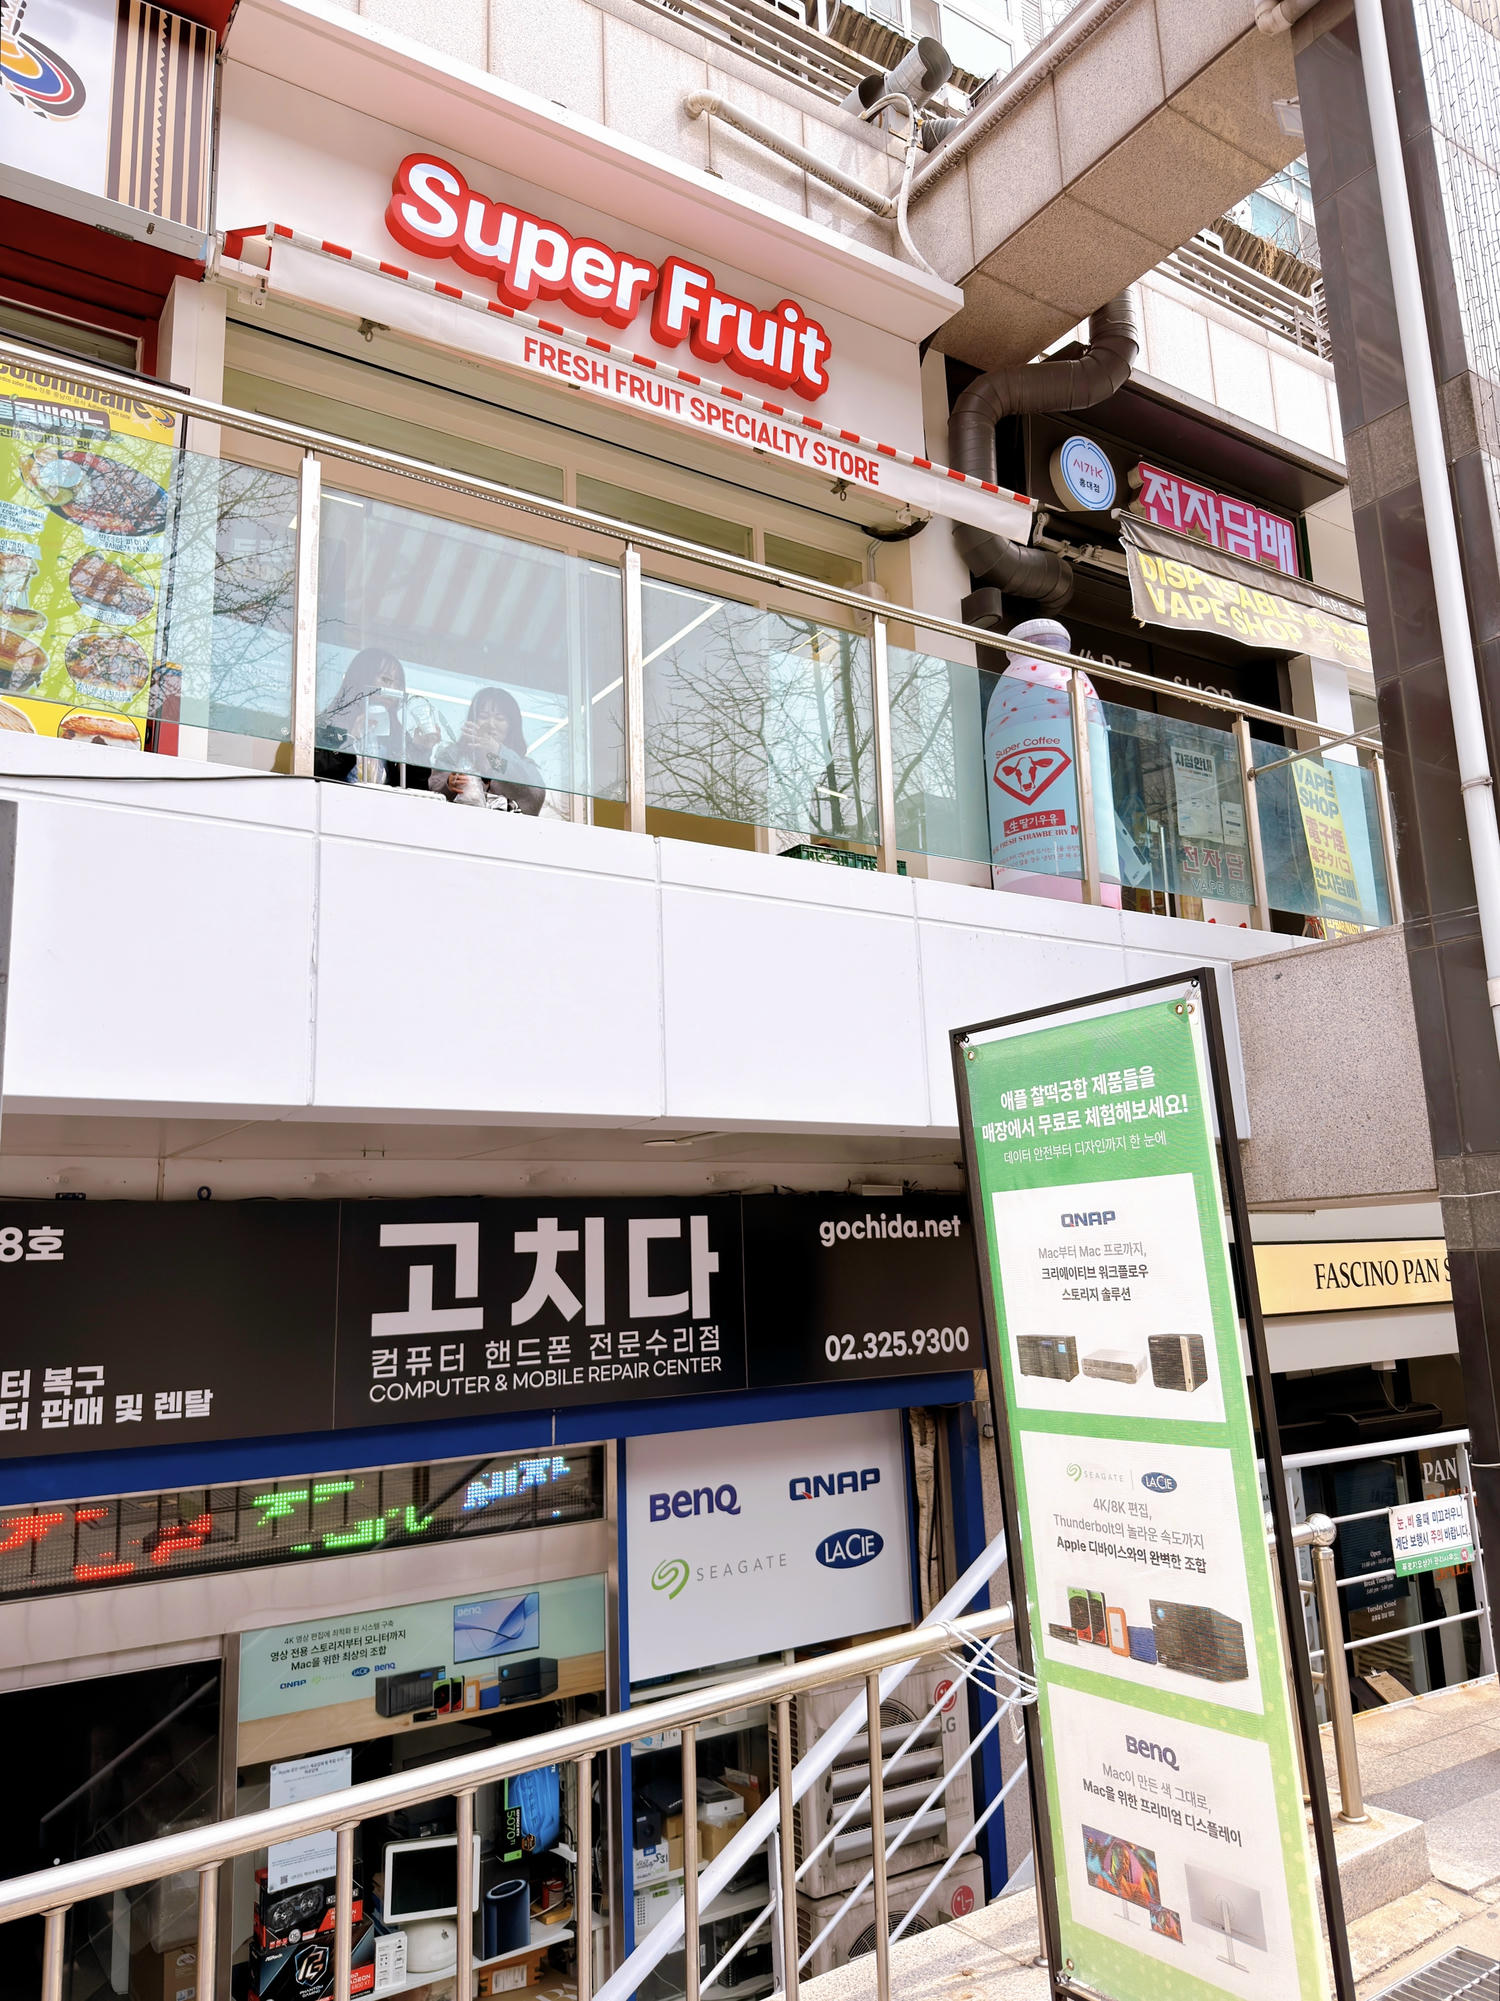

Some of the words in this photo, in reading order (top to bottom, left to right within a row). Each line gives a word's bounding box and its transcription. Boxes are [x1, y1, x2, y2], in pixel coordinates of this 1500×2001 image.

[401, 163, 650, 311] Super
[665, 264, 825, 385] Fruit
[524, 338, 609, 389] FRESH
[615, 369, 684, 414] FRUIT
[690, 397, 810, 460] SPECIALTY
[813, 441, 879, 485] STORE
[1080, 478, 1100, 493] 홍대점
[1141, 470, 1296, 575] 전자담배
[1138, 551, 1306, 622] DISPOSABLE
[1311, 591, 1348, 615] VAPE
[1145, 582, 1231, 629] VAPE
[1229, 608, 1304, 645] SHOP
[995, 742, 1021, 760] Super
[1023, 736, 1060, 747] Coffee
[1295, 762, 1335, 798] VAPE
[1299, 789, 1338, 819] SHOP
[1192, 877, 1225, 895] VAPE
[1000, 1089, 1028, 1111] 애플
[1030, 1077, 1088, 1107] 찰떡궁합
[1092, 1065, 1155, 1096] 제품들을
[982, 1116, 1035, 1143] 매장에서
[1038, 1110, 1082, 1135] 무료로
[1085, 1094, 1189, 1129] 체험해보세요!
[1004, 1149, 1032, 1164] 데이터
[1034, 1143, 1072, 1161] 안전부터
[1075, 1136, 1126, 1155] 디자인까지
[1129, 1132, 1140, 1149] 한
[1144, 1130, 1167, 1147] 눈에
[819, 1214, 961, 1247] gochida.net
[1060, 1210, 1116, 1228] QNAP
[1038, 1245, 1077, 1259] Mac부터
[1079, 1246, 1101, 1258] Mac
[1103, 1241, 1147, 1257] 프로까지,
[371, 1215, 719, 1337] 고치다
[1042, 1266, 1097, 1280] 크리에이티브
[1099, 1264, 1149, 1279] 워크플로우
[1314, 1259, 1399, 1290] FASCINO
[1402, 1258, 1440, 1284] PAN
[1062, 1287, 1099, 1301] 스토리지
[1101, 1287, 1132, 1301] 솔루션
[372, 1343, 465, 1379] 컴퓨터
[485, 1335, 572, 1368] 핸드폰
[589, 1325, 721, 1359] 전문수리점
[825, 1327, 969, 1362] 02.325.9300
[43, 1365, 105, 1397] 복구
[369, 1374, 490, 1403] COMPUTER
[495, 1373, 508, 1392] &
[512, 1366, 584, 1391] MOBILE
[588, 1361, 650, 1384] REPAIR
[653, 1356, 722, 1379] CENTER
[41, 1396, 103, 1430] 판매
[115, 1393, 143, 1422] 및
[154, 1389, 213, 1421] 렌탈
[789, 1468, 880, 1501] QNAP
[1084, 1470, 1125, 1483] SEAGATE
[1422, 1457, 1459, 1484] PAN
[649, 1484, 741, 1522] BenQ
[1093, 1497, 1126, 1515] 4K/8K
[1128, 1501, 1152, 1521] 편집,
[1053, 1513, 1125, 1539] Thunderbolt의
[1127, 1524, 1158, 1543] 놀라운
[1160, 1528, 1205, 1551] 속도까지
[1395, 1536, 1409, 1551] 계단
[1409, 1532, 1429, 1548] 보행시
[1431, 1528, 1444, 1544] 주의
[696, 1553, 788, 1582] SEAGATE
[1057, 1536, 1087, 1554] Apple
[1089, 1541, 1147, 1564] 디바이스와의
[1149, 1551, 1182, 1571] 완벽한
[1184, 1556, 1207, 1574] 조합
[270, 1651, 288, 1662] 영상
[291, 1647, 308, 1659] 전용
[311, 1639, 363, 1655] 스토리지부터
[364, 1629, 407, 1646] 모니터까지
[291, 1657, 321, 1671] Mac을
[322, 1654, 340, 1665] 위한
[342, 1648, 368, 1661] 최상의
[370, 1645, 387, 1657] 조합
[280, 1679, 307, 1689] QNAP
[1125, 1734, 1180, 1771] BenQ
[1102, 1762, 1136, 1787] Mac이
[1137, 1773, 1159, 1794] 만든
[1161, 1783, 1173, 1799] 색
[1175, 1787, 1212, 1815] 그대로,
[507, 1810, 516, 1839] 5070
[1082, 1778, 1116, 1803] Mac을
[1117, 1789, 1138, 1811] 위한
[1140, 1797, 1183, 1826] 프리미엄
[1184, 1813, 1243, 1848] 디스플레이
